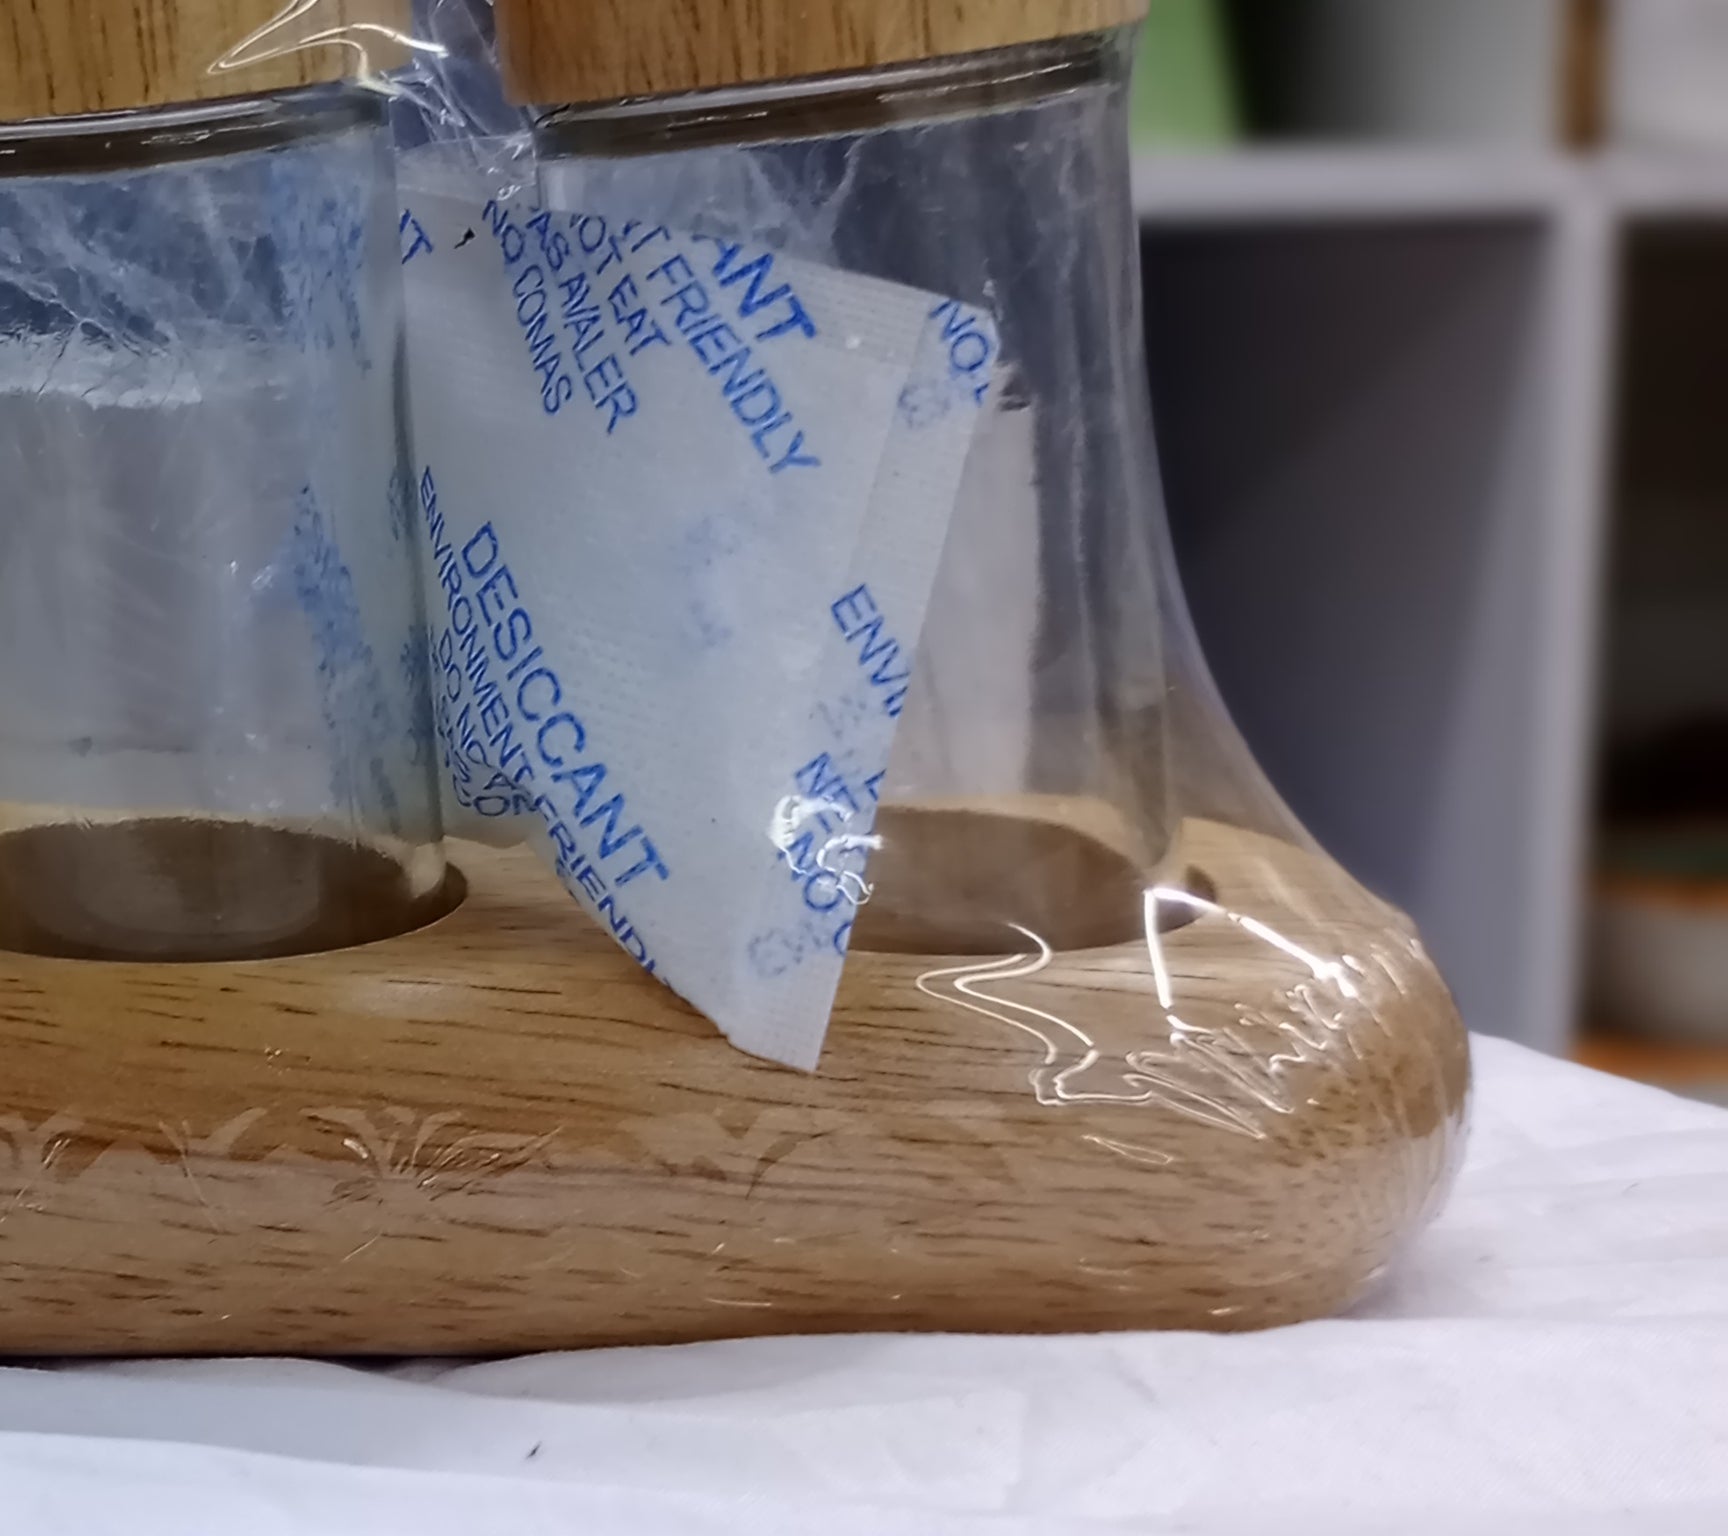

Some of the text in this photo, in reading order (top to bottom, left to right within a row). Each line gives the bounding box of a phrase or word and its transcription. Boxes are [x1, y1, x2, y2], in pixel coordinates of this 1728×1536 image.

[481, 199, 573, 414] NO COMAS
[525, 207, 638, 434] AS AVALER
[569, 214, 623, 275] OT
[607, 273, 672, 357] EAT
[646, 253, 823, 474] FRIENDLY
[420, 464, 535, 783] ENVIRONMENT
[533, 793, 671, 990] FRIEND
[456, 703, 498, 769] NO
[461, 520, 671, 887] DESICCANT
